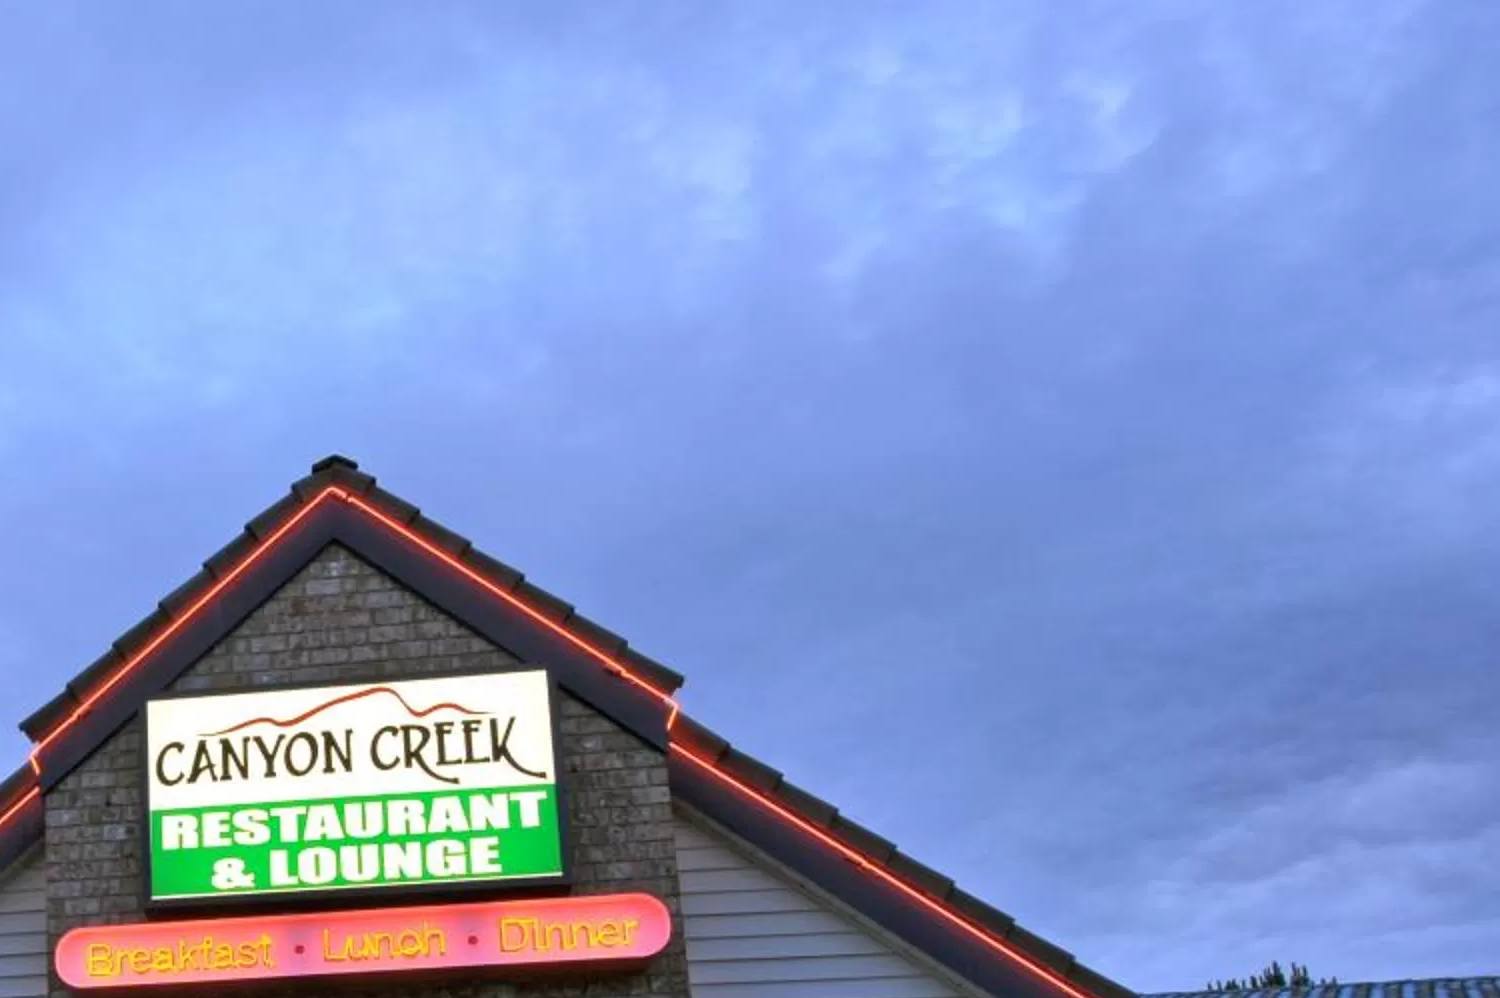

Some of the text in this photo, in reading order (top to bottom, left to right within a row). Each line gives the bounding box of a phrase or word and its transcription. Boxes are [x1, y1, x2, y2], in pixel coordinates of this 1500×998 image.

[156, 715, 548, 786] CANYON CREEK
[161, 791, 547, 850] RESTAURANT
[212, 837, 502, 889] & LOUNGE
[87, 917, 640, 977] Breakfast Lunch Dinner
